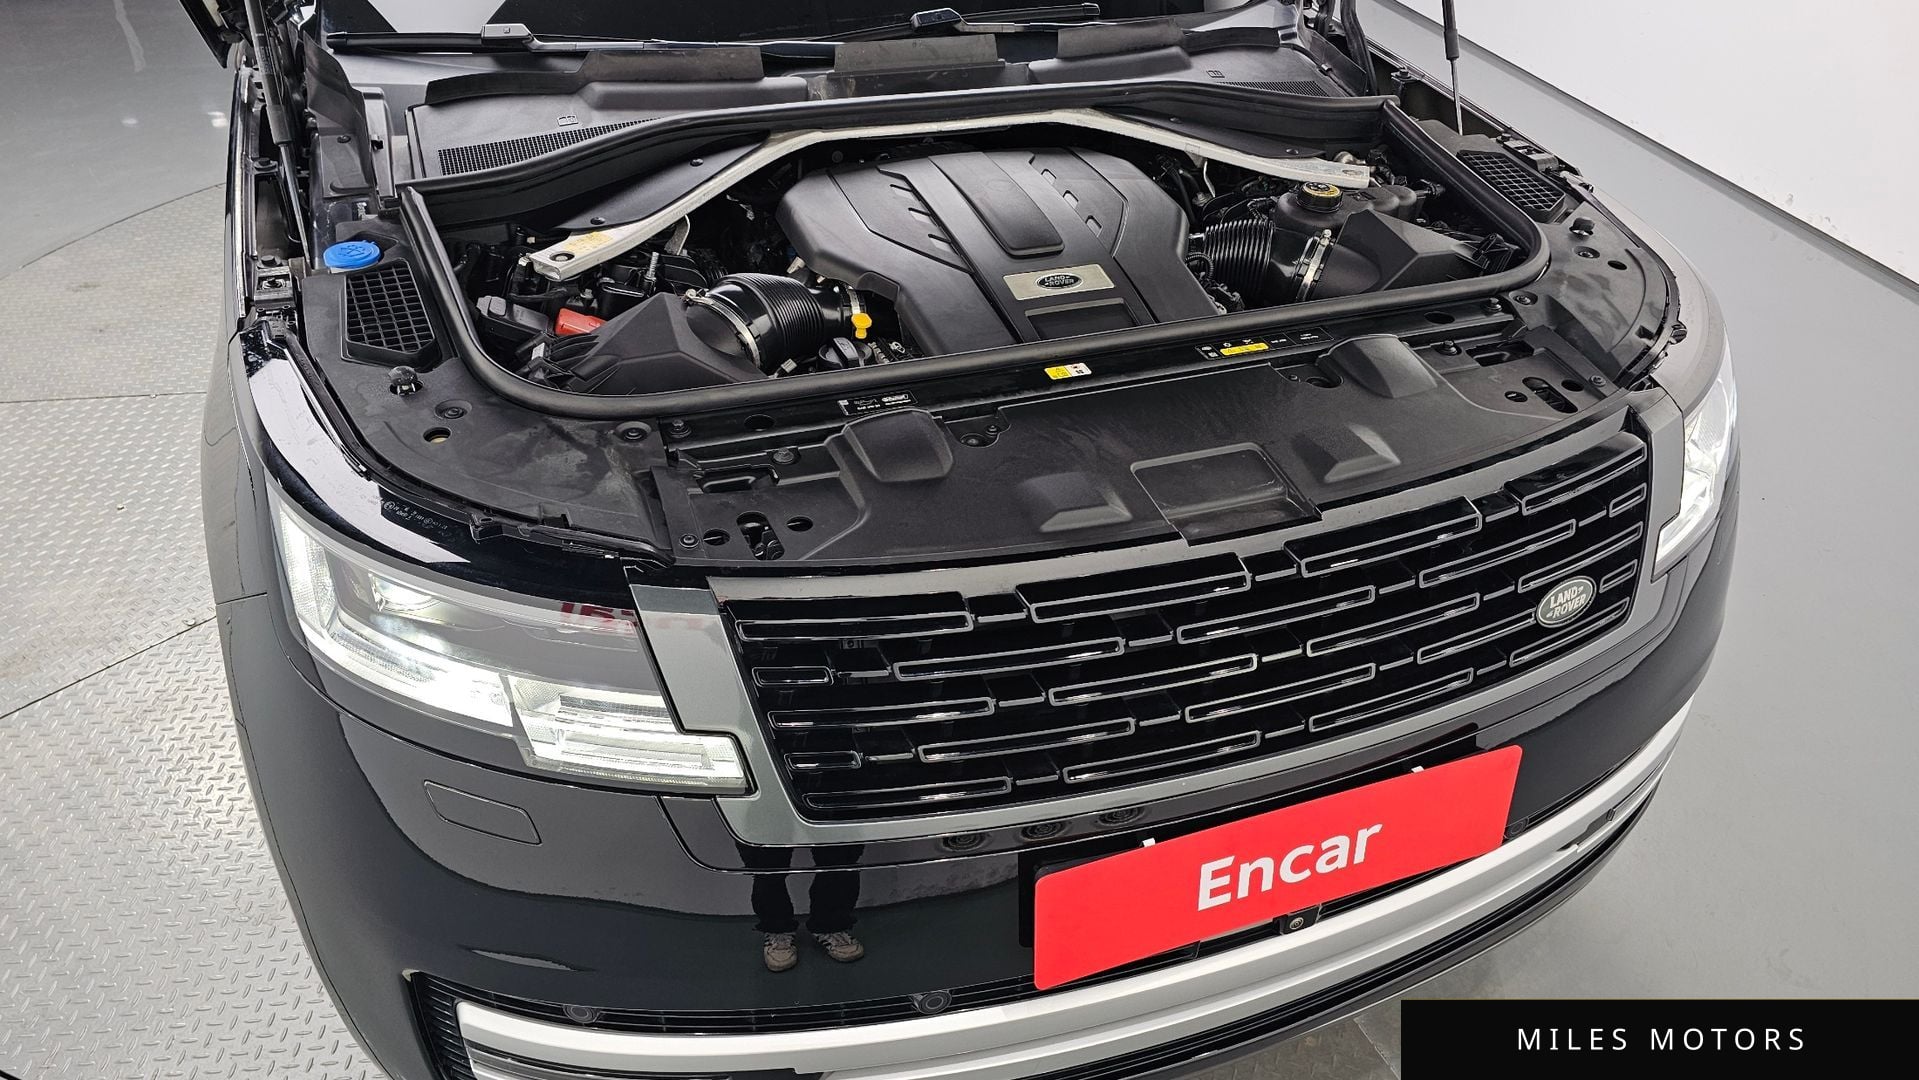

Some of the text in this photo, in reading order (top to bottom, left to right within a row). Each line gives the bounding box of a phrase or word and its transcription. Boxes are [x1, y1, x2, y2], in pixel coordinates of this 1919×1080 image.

[1049, 278, 1075, 286] ROVER
[1549, 586, 1578, 609] LAND
[1552, 593, 1587, 619] ROVER
[1197, 823, 1383, 912] Encar
